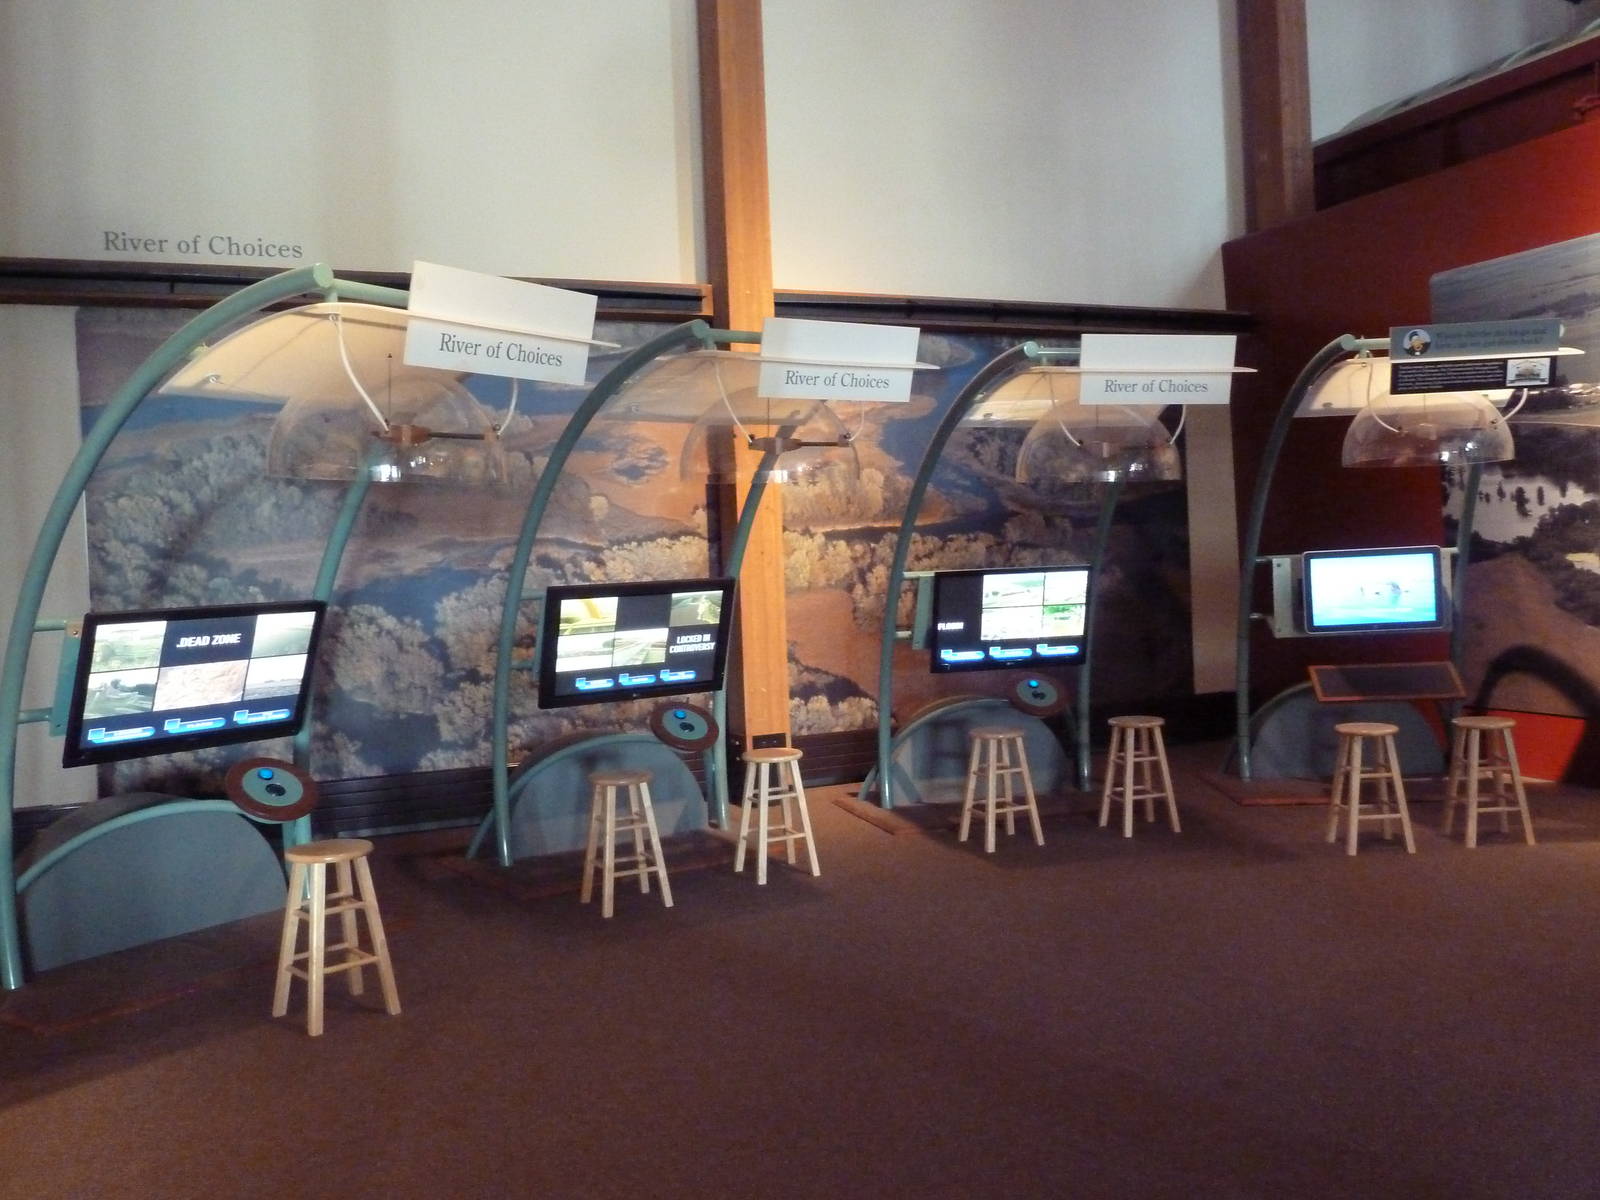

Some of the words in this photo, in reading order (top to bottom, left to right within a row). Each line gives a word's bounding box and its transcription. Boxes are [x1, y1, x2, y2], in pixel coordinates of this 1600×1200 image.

[103, 231, 169, 253] River
[177, 235, 201, 254] of
[208, 235, 304, 259] Choices
[439, 332, 482, 356] River
[486, 341, 503, 359] of
[506, 342, 563, 367] Choices
[784, 369, 820, 386] River
[823, 372, 838, 387] of
[840, 373, 890, 389] Choices
[1104, 379, 1138, 393] River
[1142, 379, 1156, 393] of
[1158, 378, 1209, 393] Choices
[211, 633, 242, 646] ZONE
